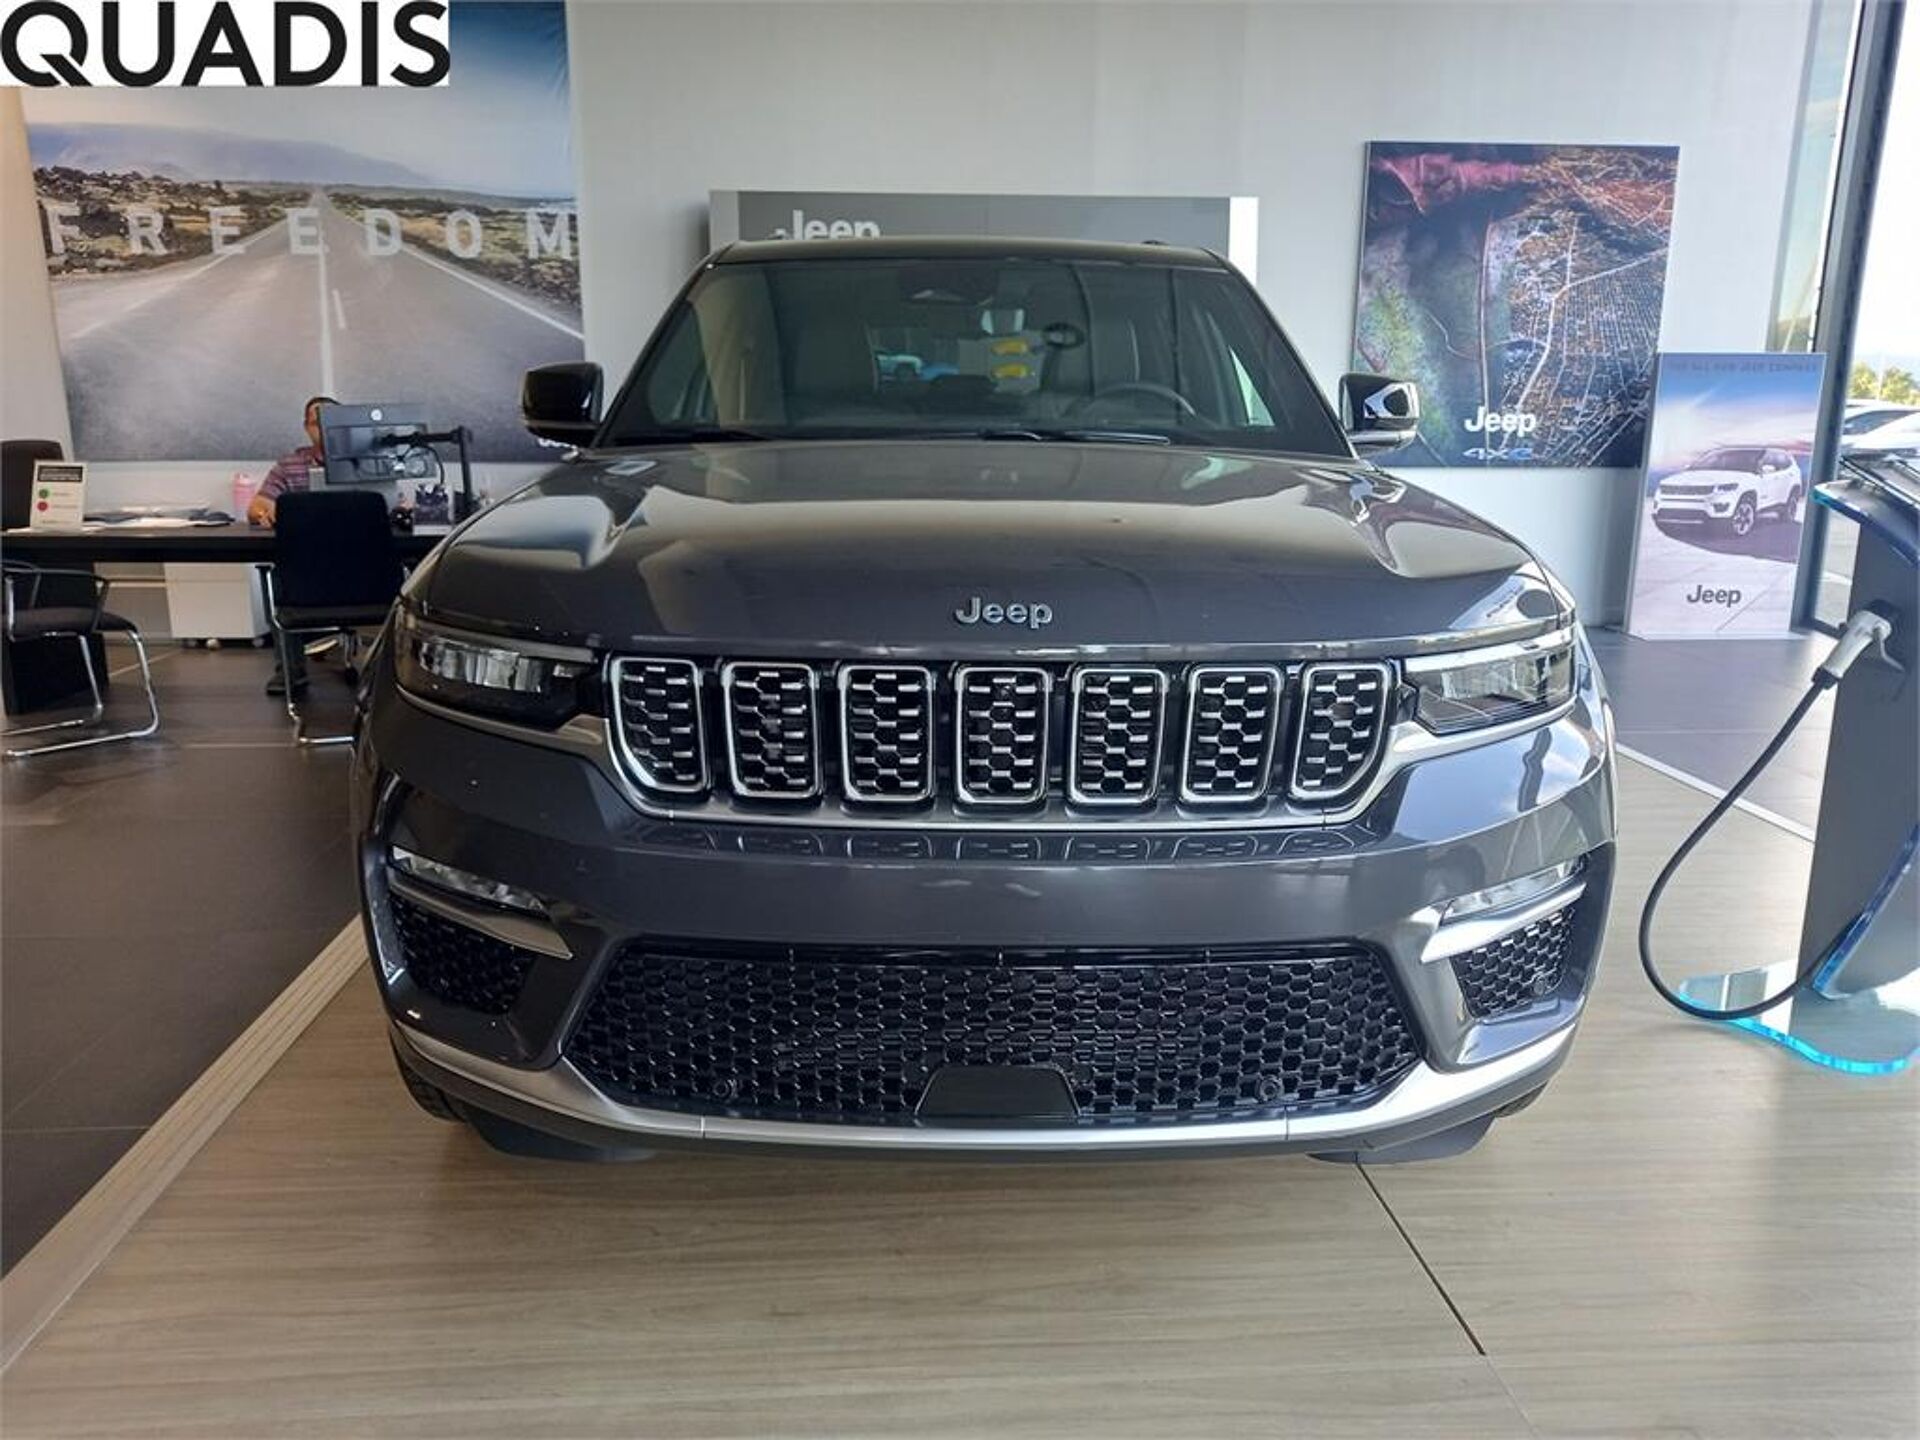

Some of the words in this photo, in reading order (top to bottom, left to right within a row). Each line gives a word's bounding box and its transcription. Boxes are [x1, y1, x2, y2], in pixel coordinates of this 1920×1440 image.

[46, 201, 575, 261] FREEDOM
[1464, 406, 1537, 437] Jeep
[1686, 584, 1743, 608] Jeep
[955, 597, 1053, 629] Jeep
